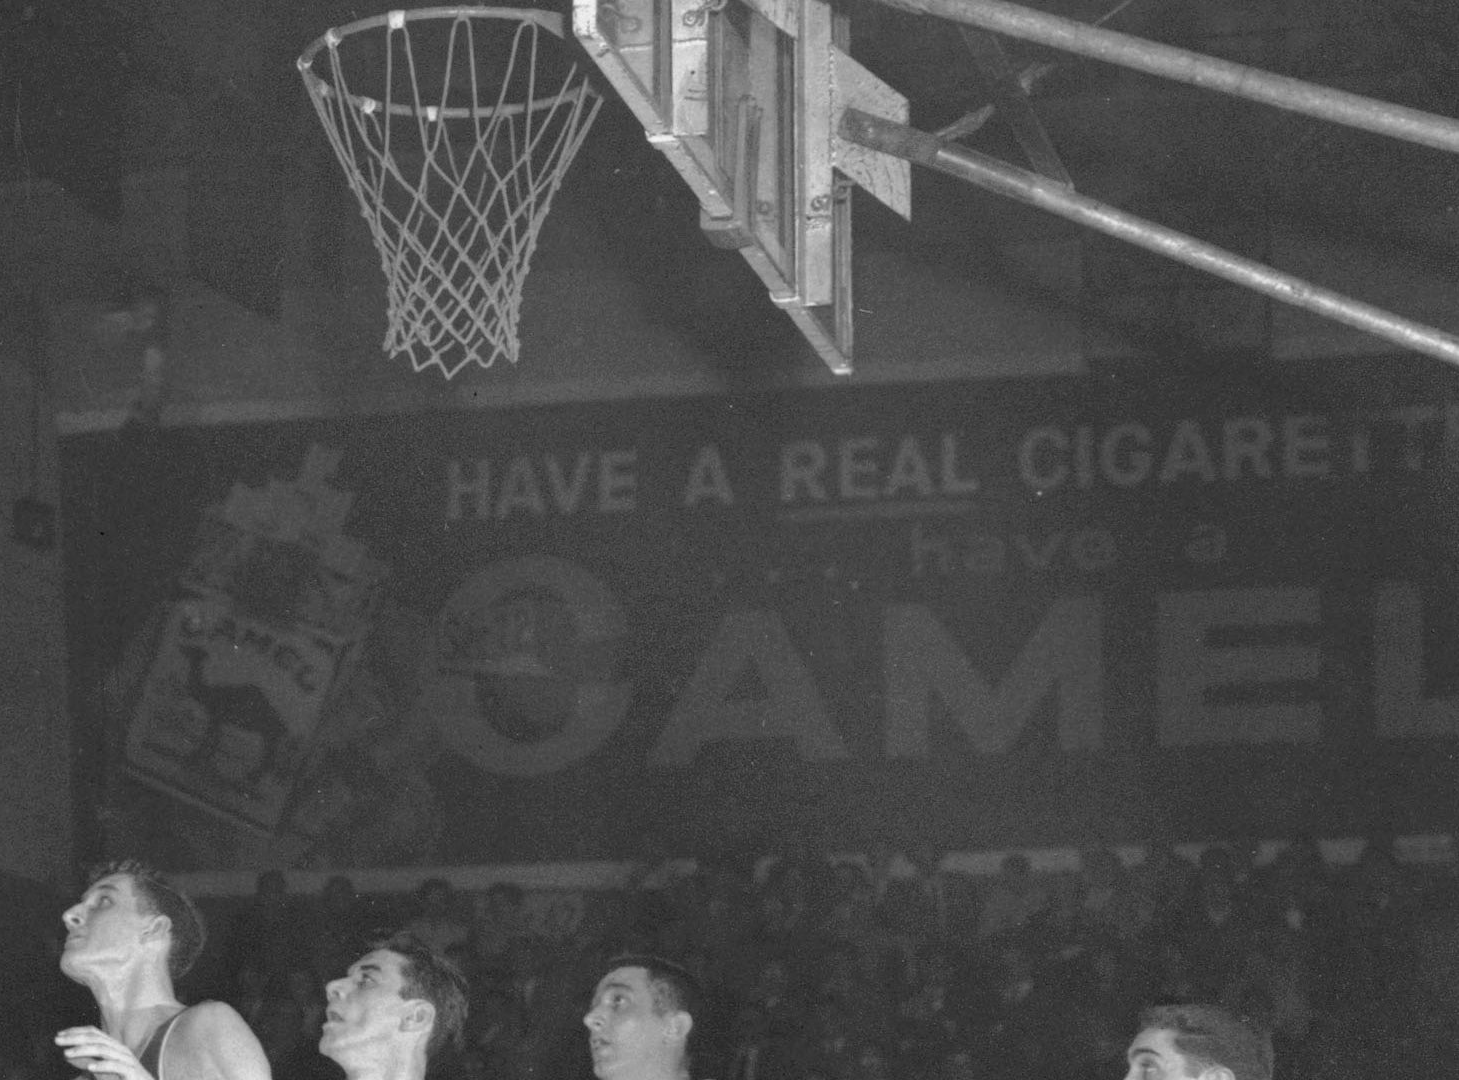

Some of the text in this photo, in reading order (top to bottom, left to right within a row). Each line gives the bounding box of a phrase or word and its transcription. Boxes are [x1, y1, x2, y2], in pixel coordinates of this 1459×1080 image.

[446, 450, 637, 520] HAVE
[683, 442, 735, 506] A
[778, 432, 980, 502] REAL
[908, 519, 1229, 577] have a
[427, 556, 1459, 778] CAMEL
